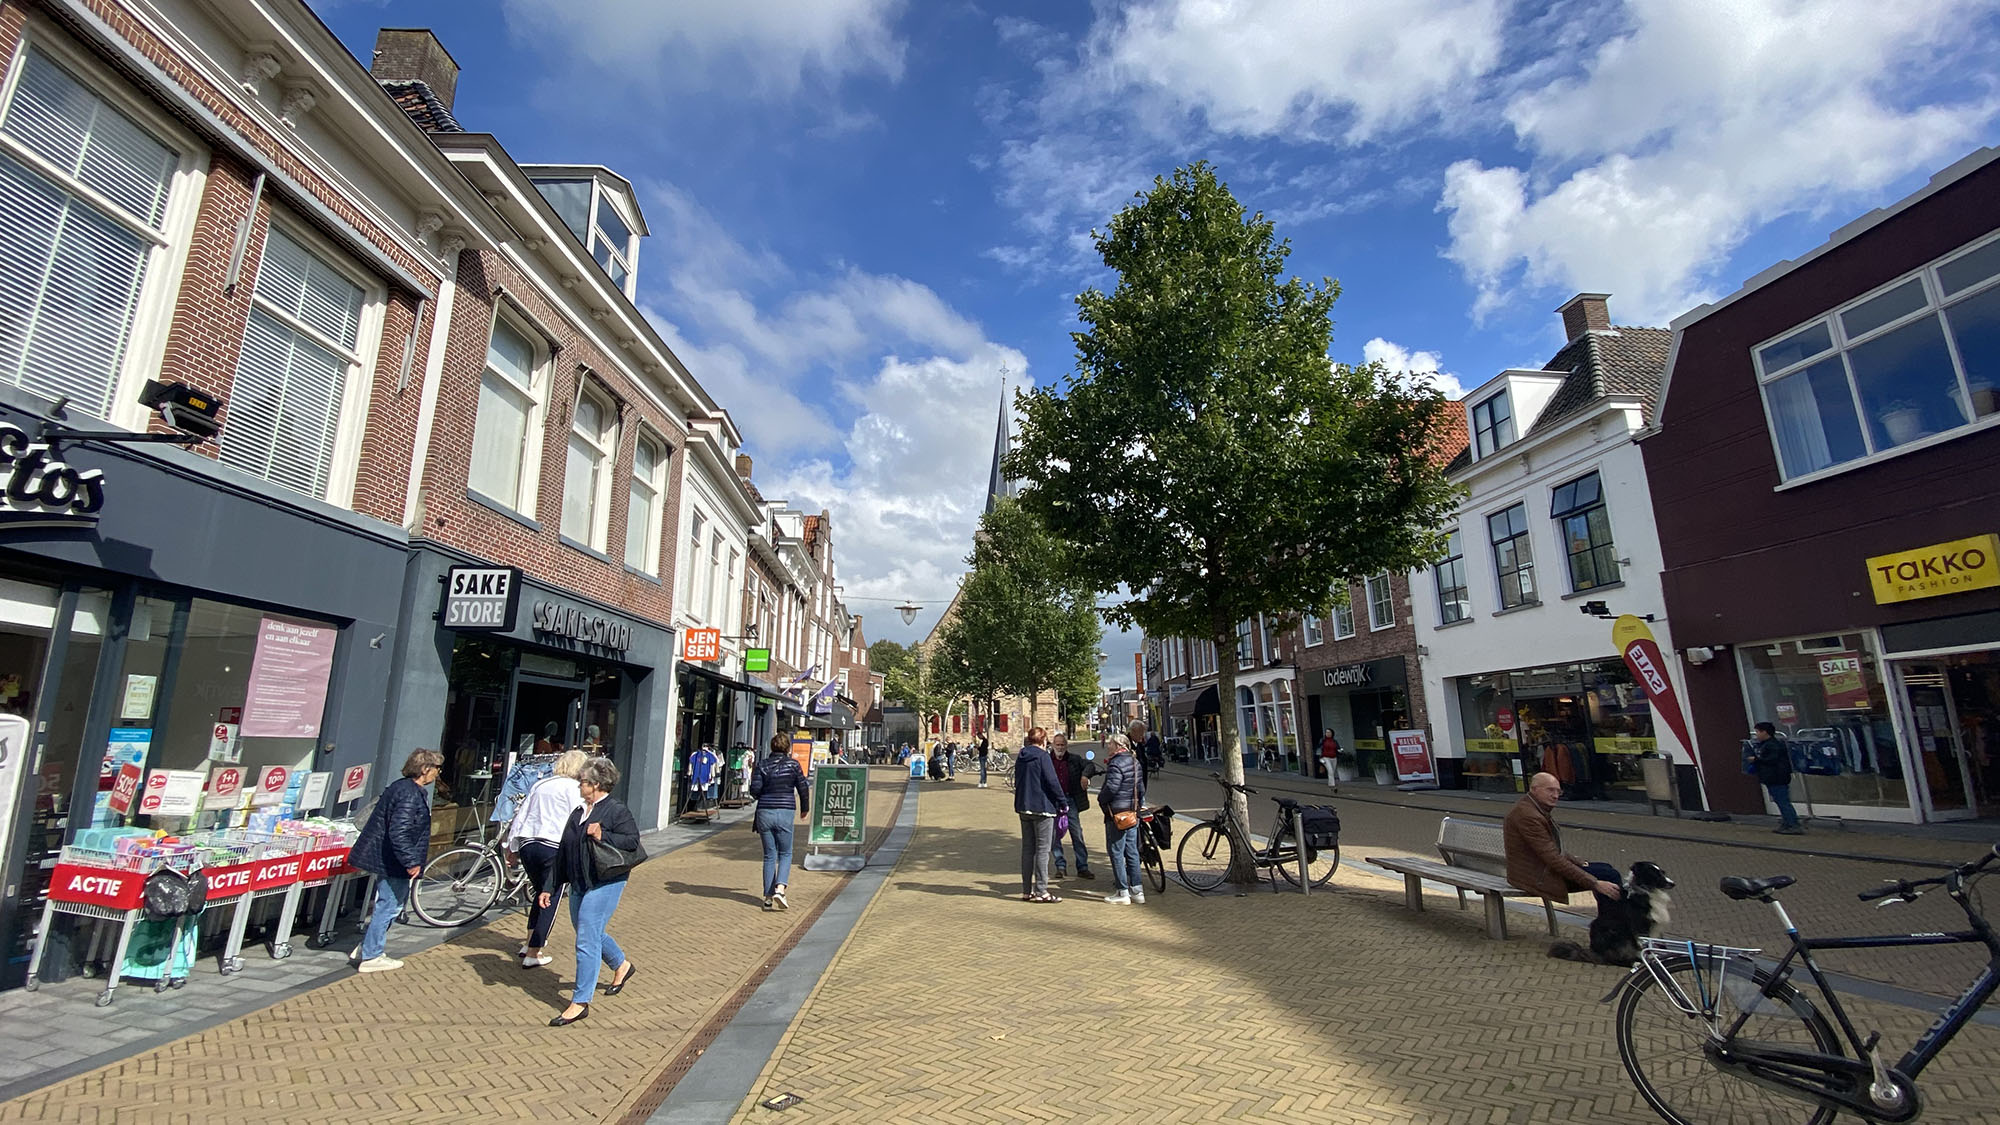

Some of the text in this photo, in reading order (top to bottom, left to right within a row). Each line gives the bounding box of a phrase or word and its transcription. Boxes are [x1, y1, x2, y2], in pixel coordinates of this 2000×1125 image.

[454, 573, 507, 595] SAKE
[1898, 575, 1973, 593] FASHION
[449, 600, 503, 623] STORE
[267, 621, 319, 637] denk aan jezelf
[536, 601, 588, 641] SAKE
[264, 633, 275, 641] en
[275, 635, 289, 643] aan
[688, 631, 716, 644] JEN
[687, 645, 715, 657] SEN
[1822, 660, 1857, 673] SALE
[116, 774, 136, 796] 50%
[830, 783, 853, 796] STIP
[828, 797, 852, 809] SALE
[256, 861, 300, 882] ACTIE
[305, 854, 345, 873] ACTIE
[68, 875, 123, 897] ACTIE
